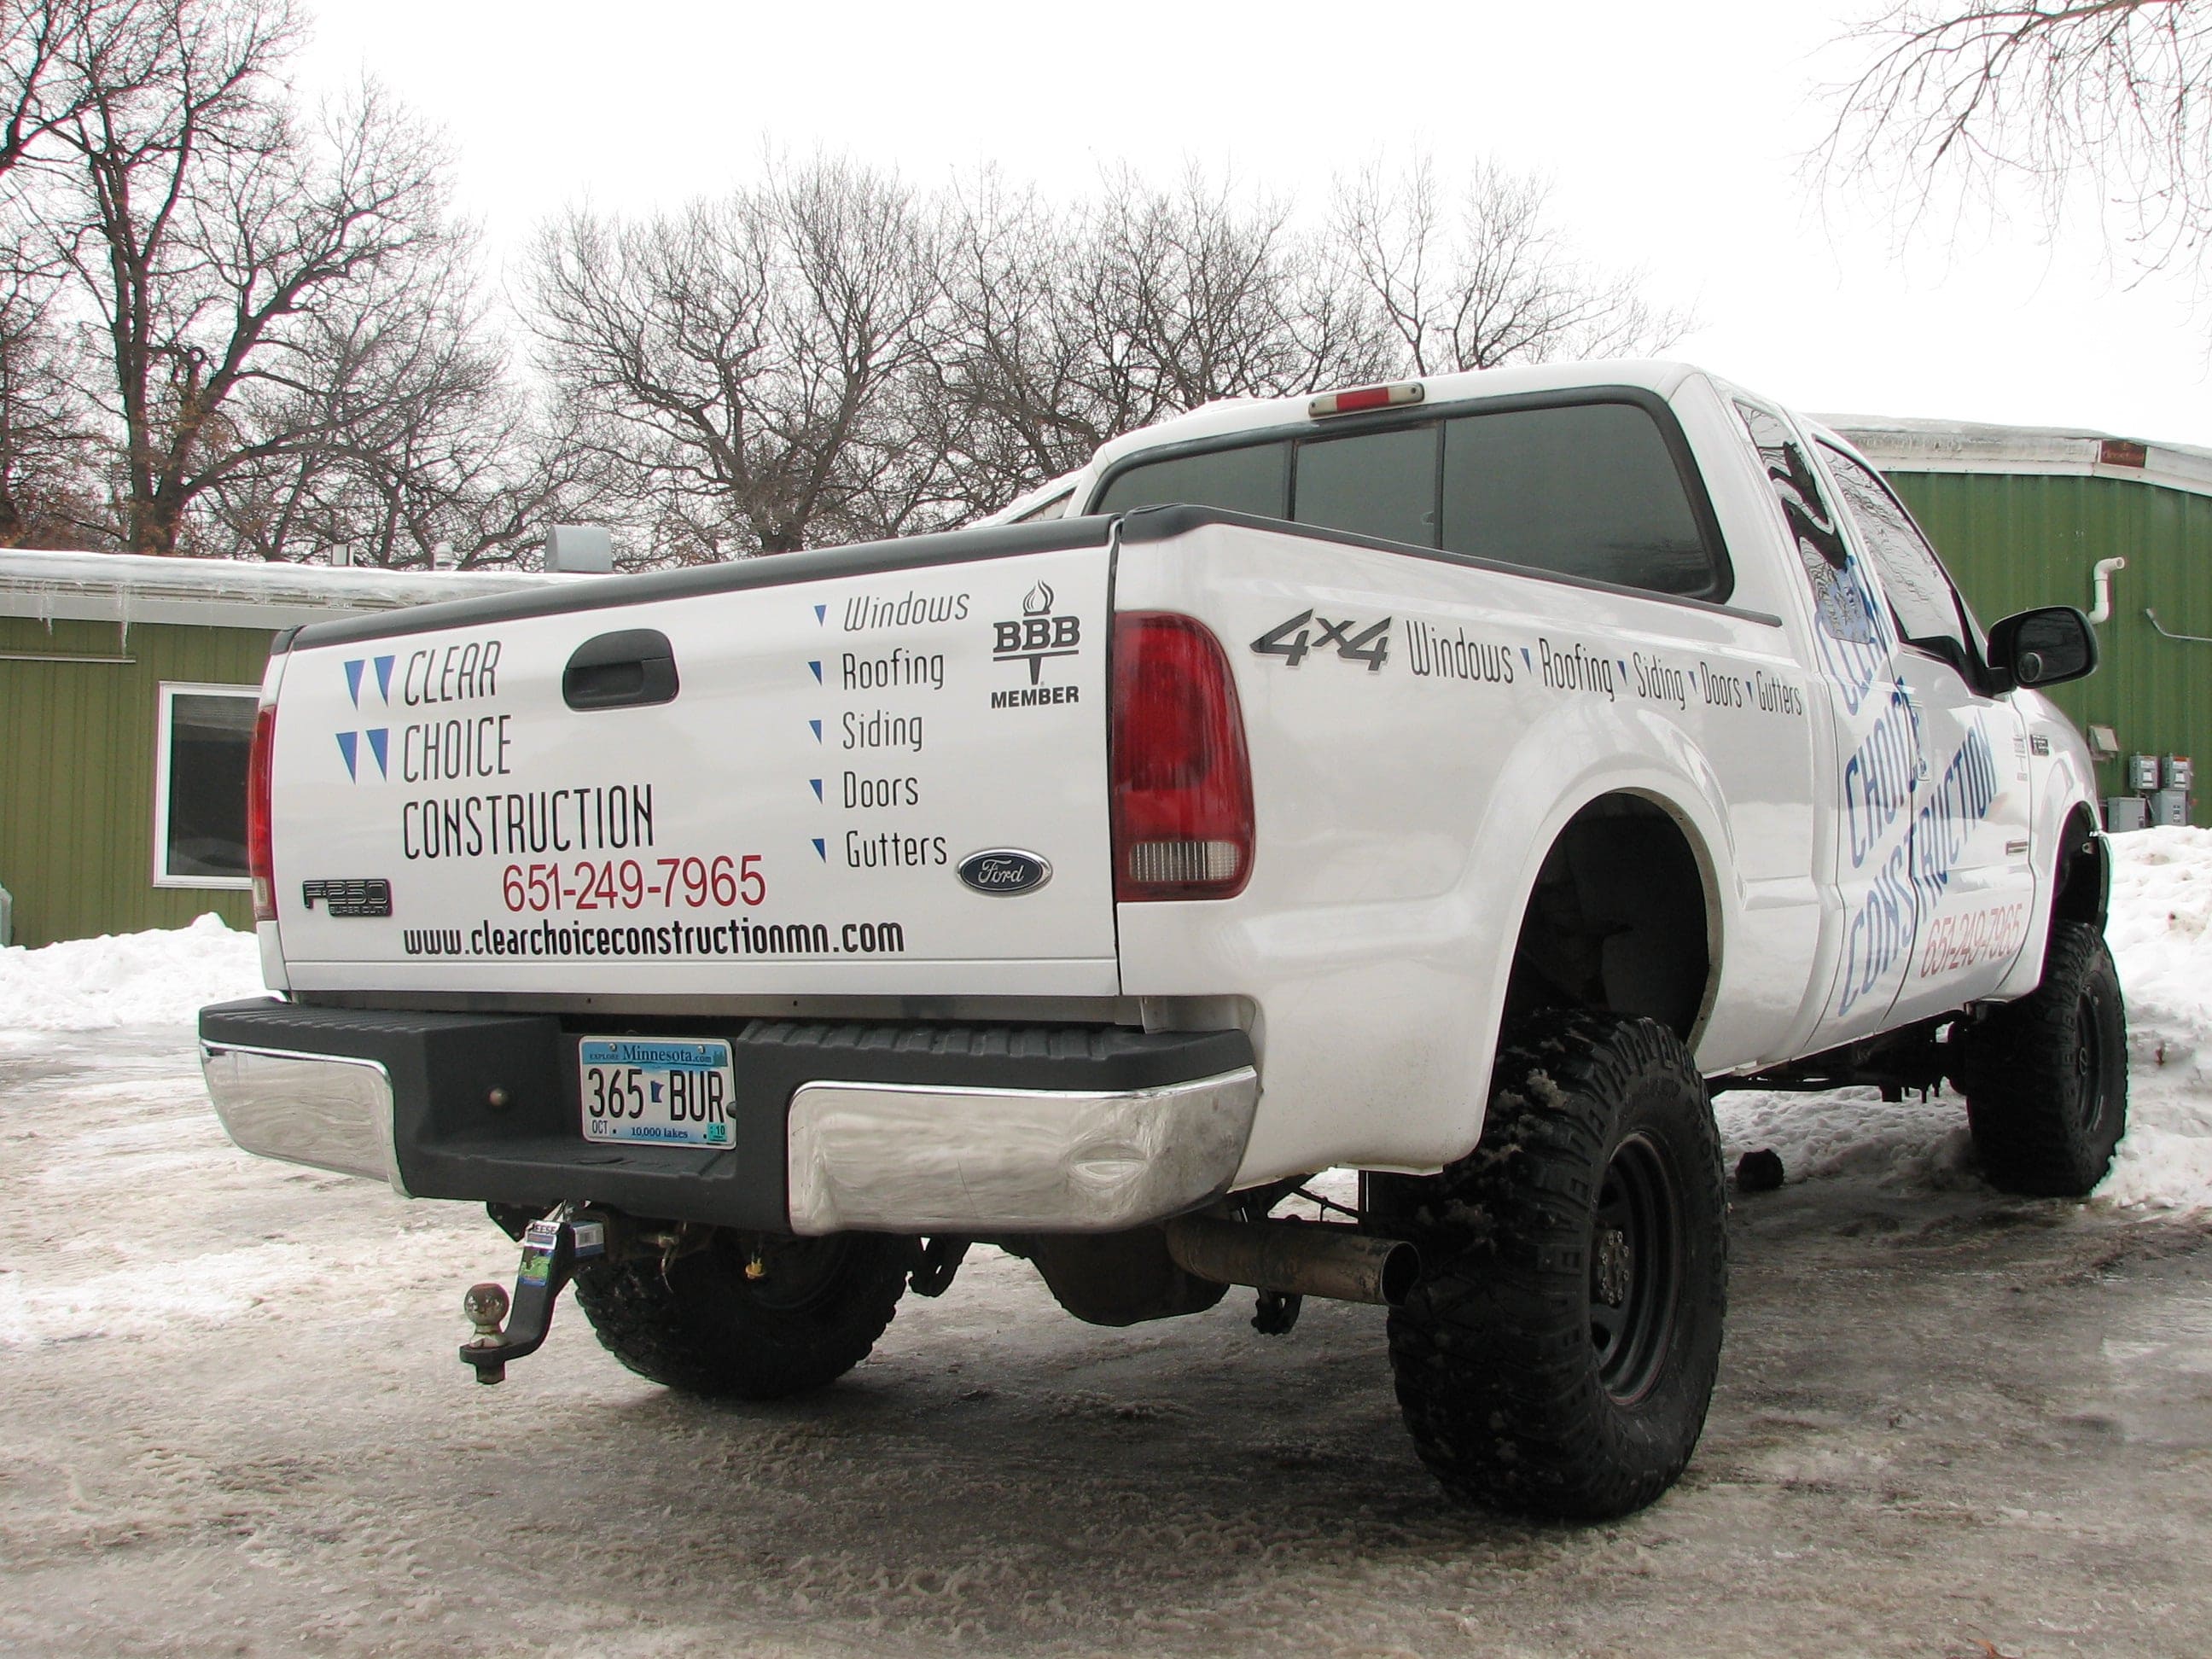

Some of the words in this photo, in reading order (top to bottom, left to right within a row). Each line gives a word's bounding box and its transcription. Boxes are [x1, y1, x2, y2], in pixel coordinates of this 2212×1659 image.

[844, 591, 969, 632] Windows
[992, 616, 1080, 654] BBB
[405, 641, 501, 706] CLEAR
[843, 648, 944, 690] Roofing
[1406, 620, 1513, 684] Windows
[1539, 638, 1614, 701] Roofing
[1633, 652, 1685, 710] Siding
[1700, 661, 1742, 707] Doors
[1756, 671, 1802, 715] Gutters
[991, 686, 1080, 708] MEMBER
[404, 715, 510, 783] CHOICE
[843, 710, 923, 752] Siding
[844, 771, 919, 808] Doors
[404, 784, 655, 859] CONSTRUCTION
[846, 830, 947, 867] Gutters
[1839, 707, 1997, 1016] CONSTRUCTION
[503, 854, 765, 911] 651-249-7965
[977, 859, 1024, 883] Ford
[404, 917, 905, 955] www.clearchoiceconstructionmn.com
[588, 1068, 643, 1119] 365
[670, 1070, 725, 1123] BUR
[592, 1120, 608, 1134] OCT
[632, 1126, 661, 1137] 10,000
[664, 1127, 689, 1139] lakes
[716, 1125, 725, 1136] 10
[533, 1224, 556, 1235] EESE
